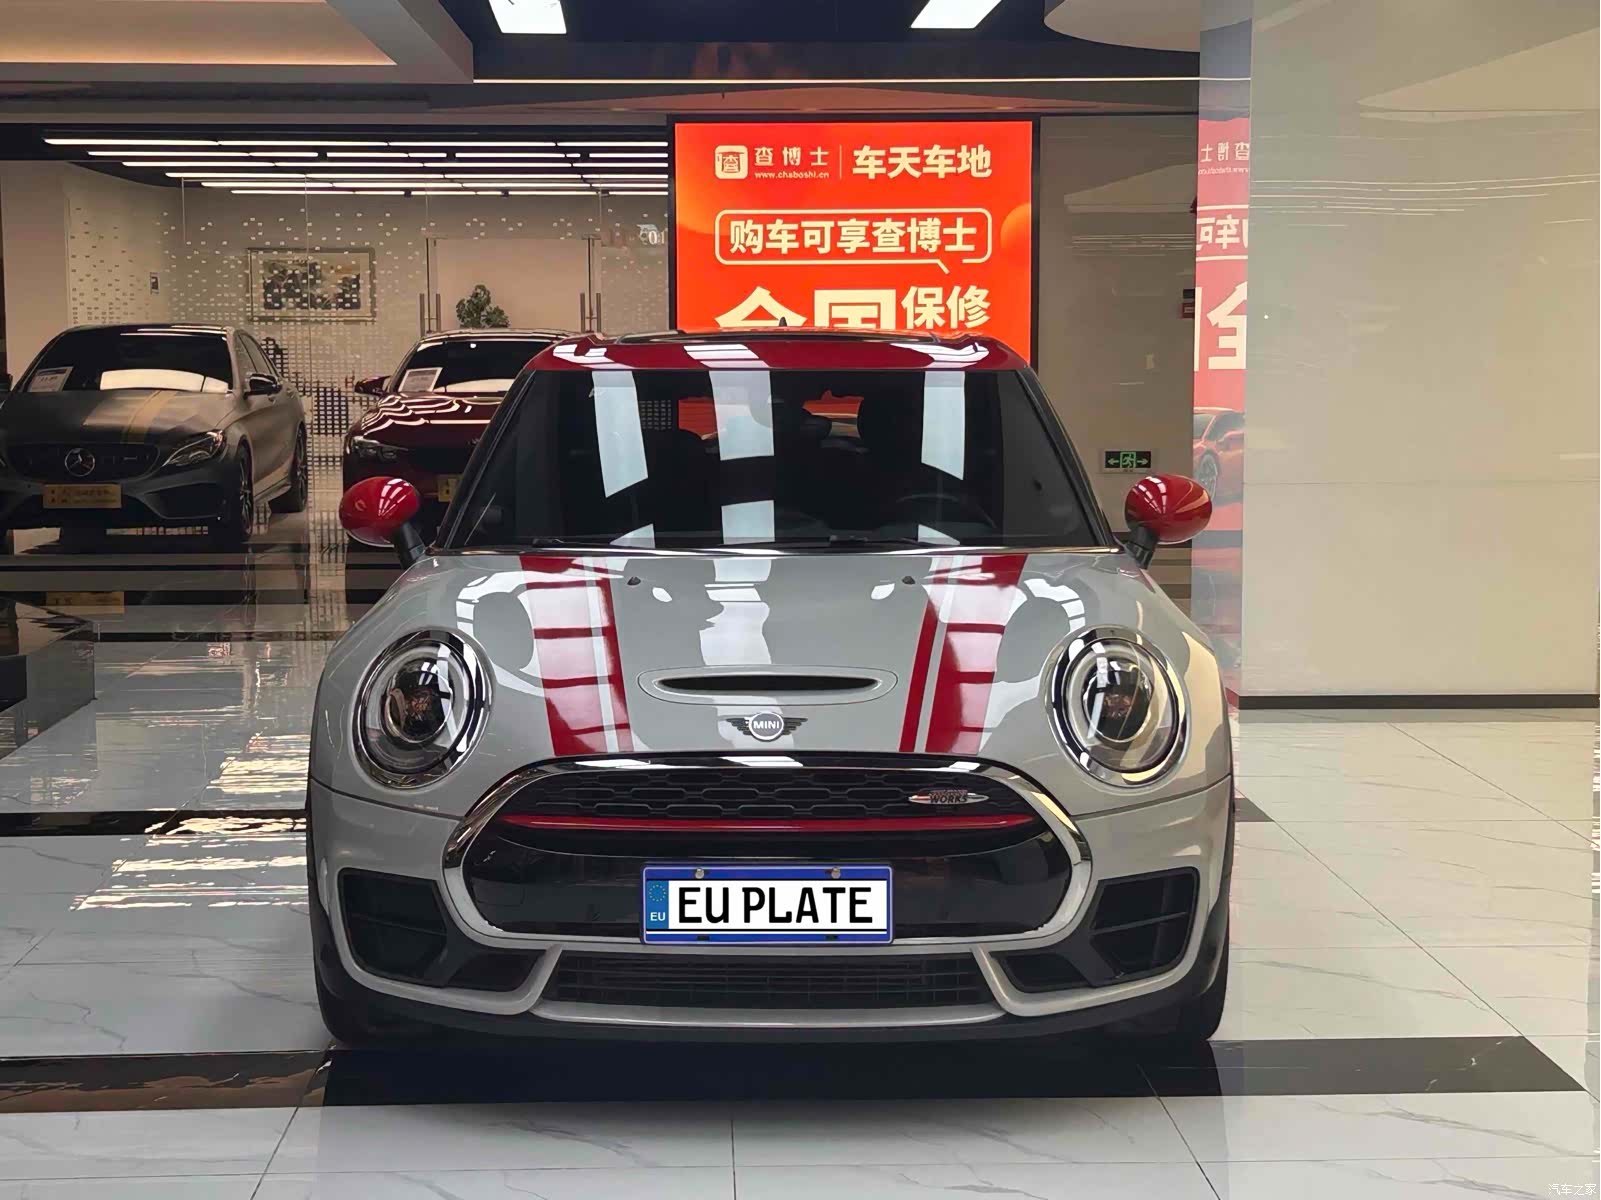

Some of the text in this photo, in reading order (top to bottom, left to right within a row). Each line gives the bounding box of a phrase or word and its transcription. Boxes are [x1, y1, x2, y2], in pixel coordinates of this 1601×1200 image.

[754, 146, 829, 167] 查博士
[852, 144, 992, 180] 车天车地
[754, 171, 829, 179] www.chaboshi.cn
[730, 217, 977, 254] 购车可享查博士
[901, 285, 991, 329] 保修
[753, 720, 780, 729] MINI
[650, 912, 666, 921] EU
[678, 887, 873, 924] EU PLATE
